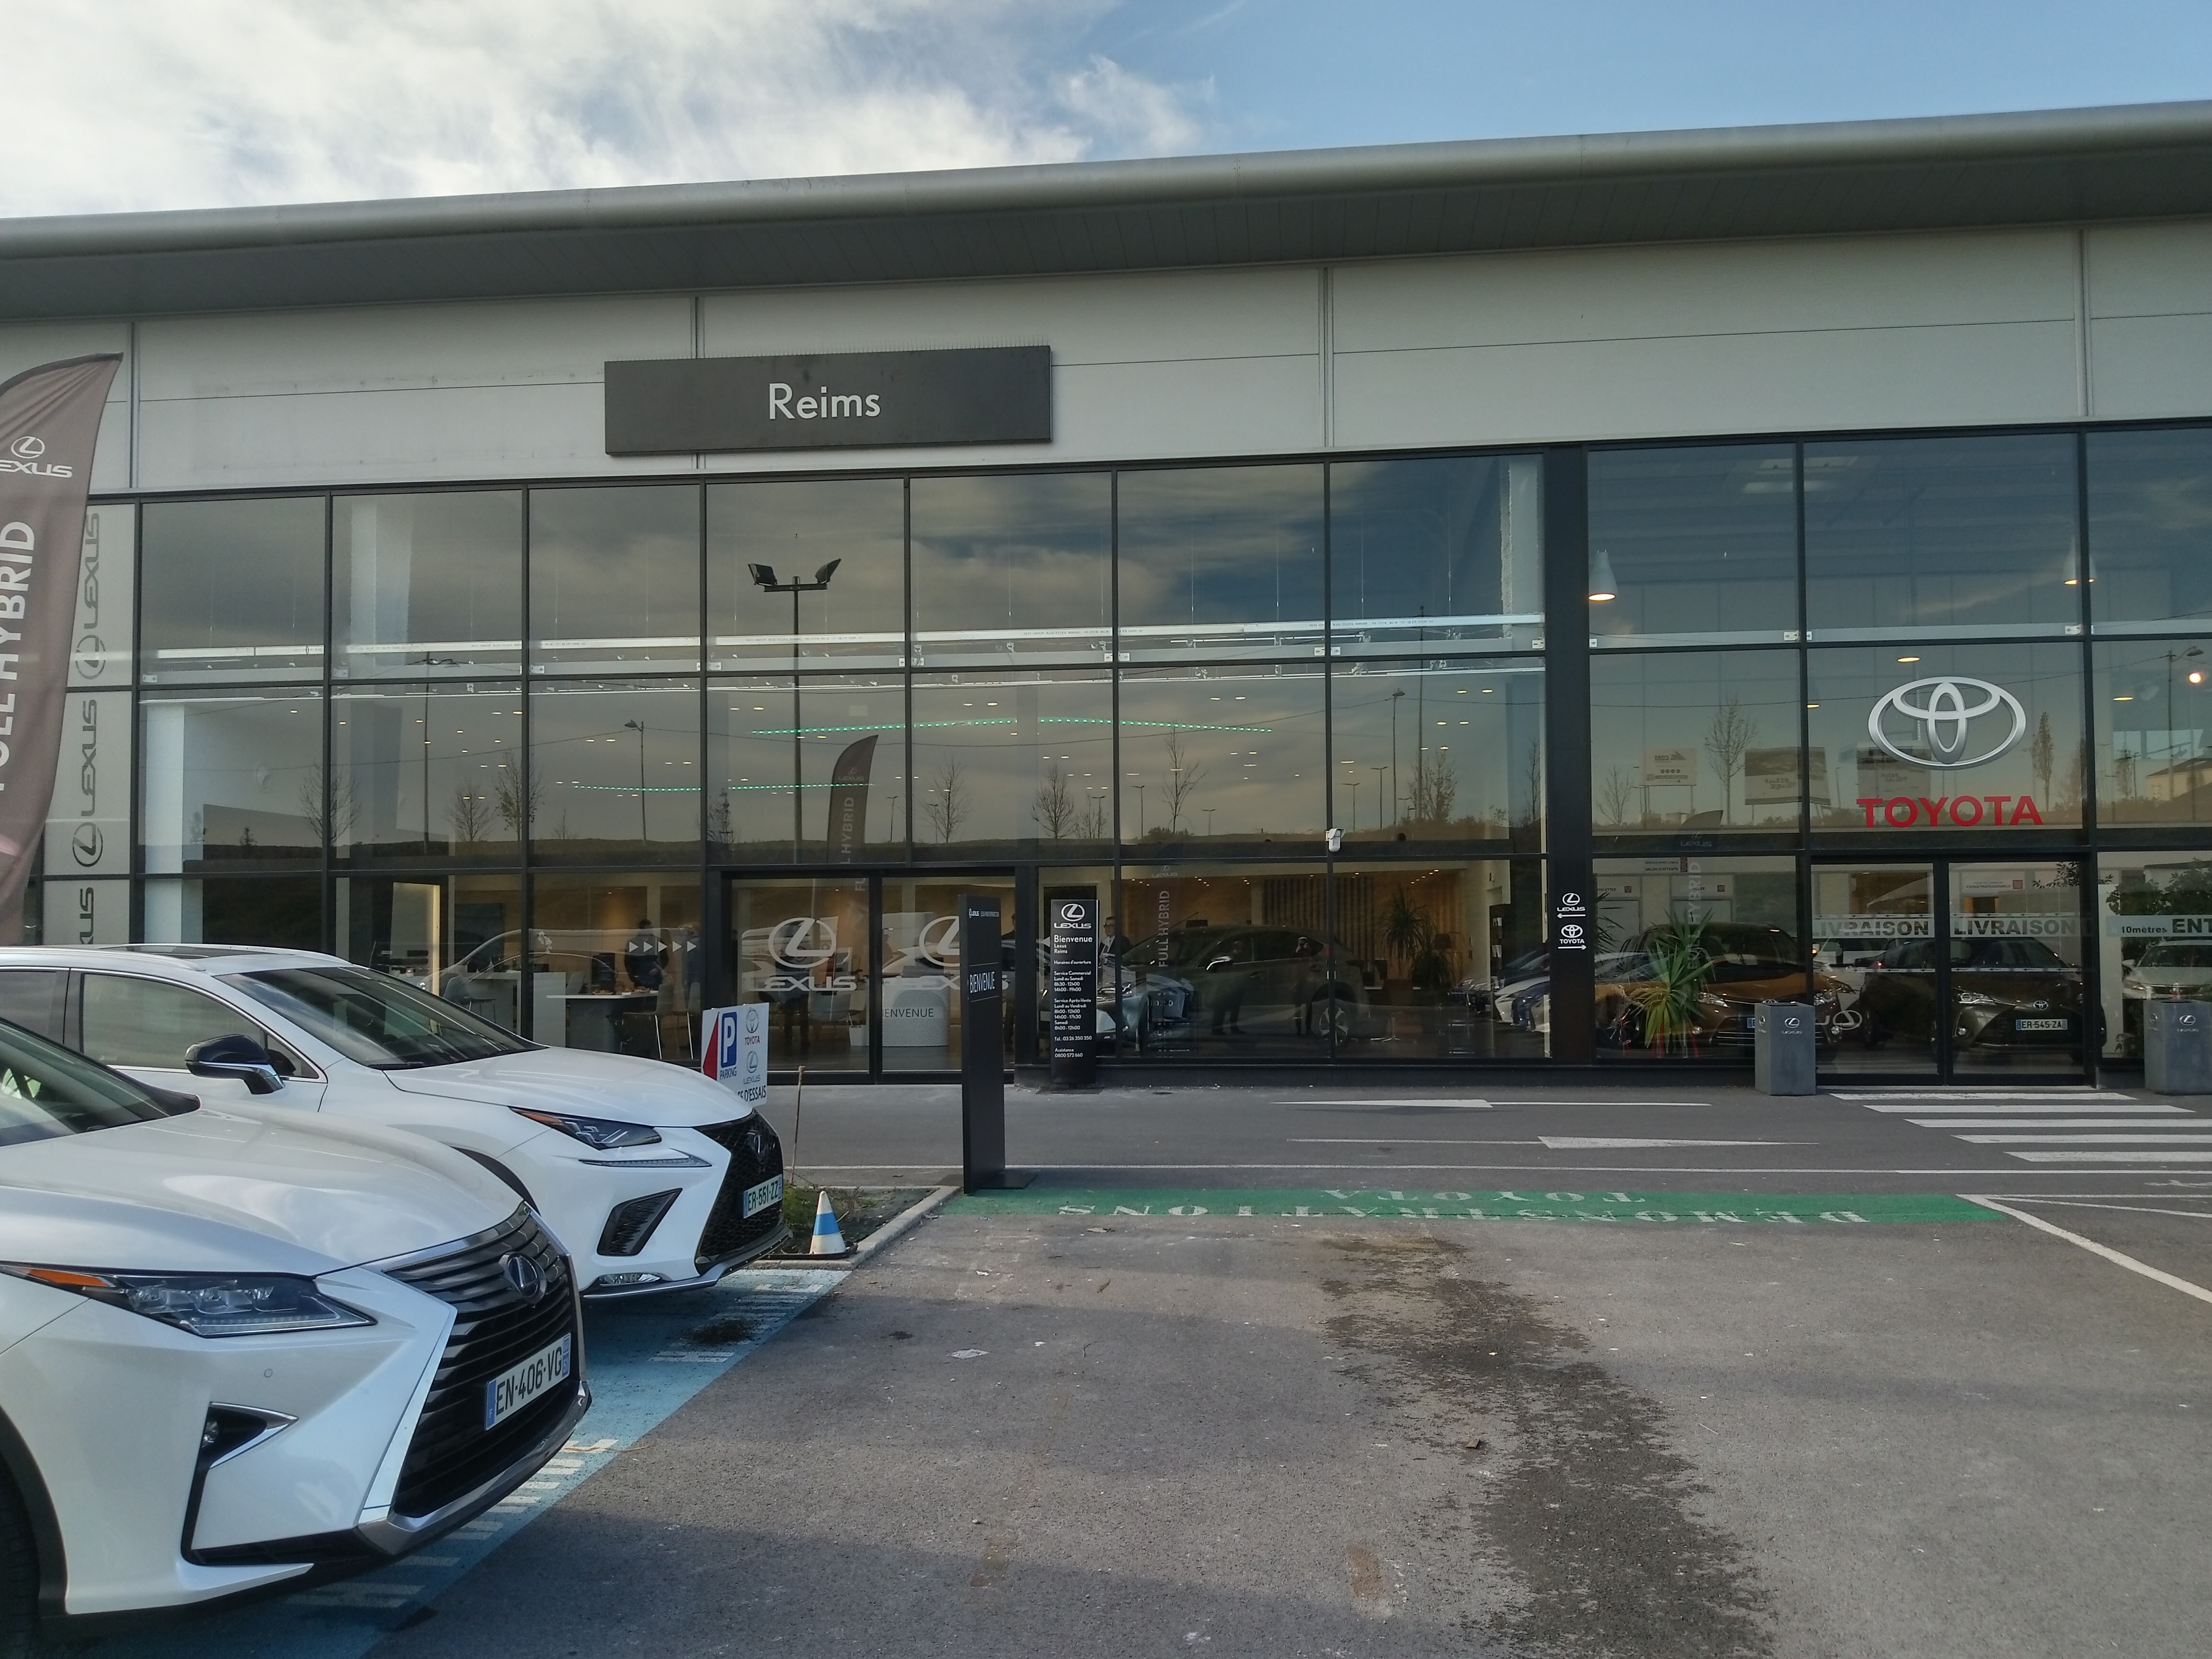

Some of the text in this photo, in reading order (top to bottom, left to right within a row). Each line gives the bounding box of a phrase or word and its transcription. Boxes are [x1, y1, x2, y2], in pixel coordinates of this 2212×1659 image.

[770, 383, 880, 419] Reims
[0, 460, 72, 478] EXUS
[84, 513, 99, 629] LEXUS
[81, 699, 97, 816] LEXUS
[841, 797, 854, 854] HYBRID
[1856, 796, 2043, 828] TOYOTA
[1054, 935, 1093, 943] Bienvenue
[1158, 890, 1170, 967] FULL HYBRID
[1954, 919, 2076, 935] LIVRAISON
[970, 971, 995, 993] BIENVENUE
[723, 1017, 735, 1063] P
[745, 1035, 760, 1045] TOYOTA
[720, 1067, 737, 1080] PARKING
[743, 1075, 760, 1084] LEXUS
[744, 1085, 767, 1101] D'ESSAIS
[748, 1180, 778, 1212] ER-551-ZZ
[1326, 1190, 1645, 1203] TOYOTA
[496, 1346, 562, 1416] EN-406-VG
